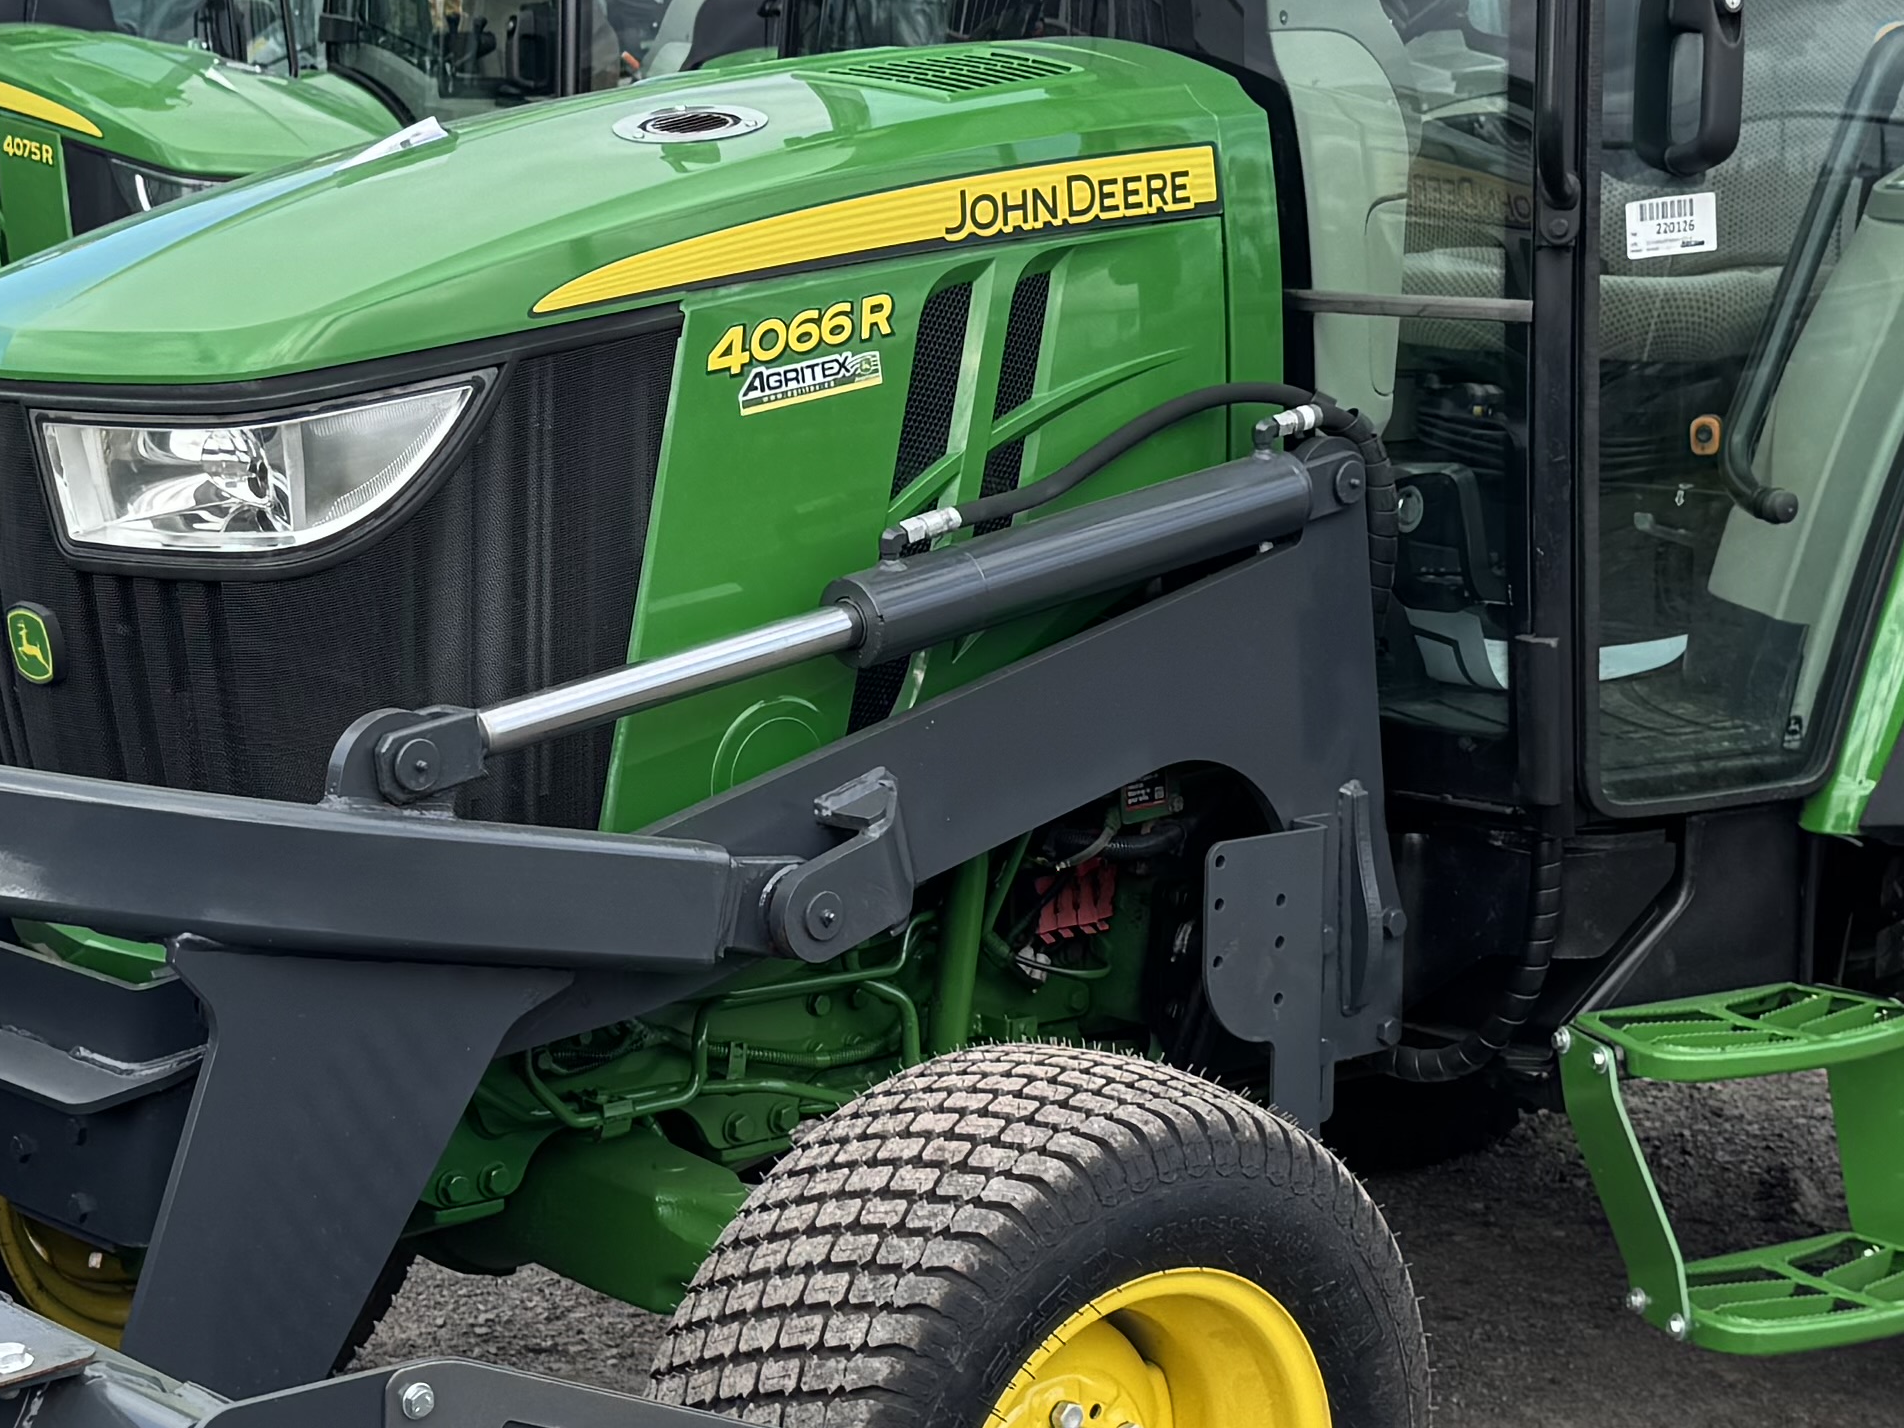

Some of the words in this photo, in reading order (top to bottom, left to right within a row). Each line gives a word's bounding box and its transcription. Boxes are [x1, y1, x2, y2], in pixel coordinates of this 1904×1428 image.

[945, 185, 1057, 234] JOHN
[1066, 170, 1191, 218] DEERE
[1656, 220, 1695, 234] 220126
[742, 355, 851, 397] AGRITEX
